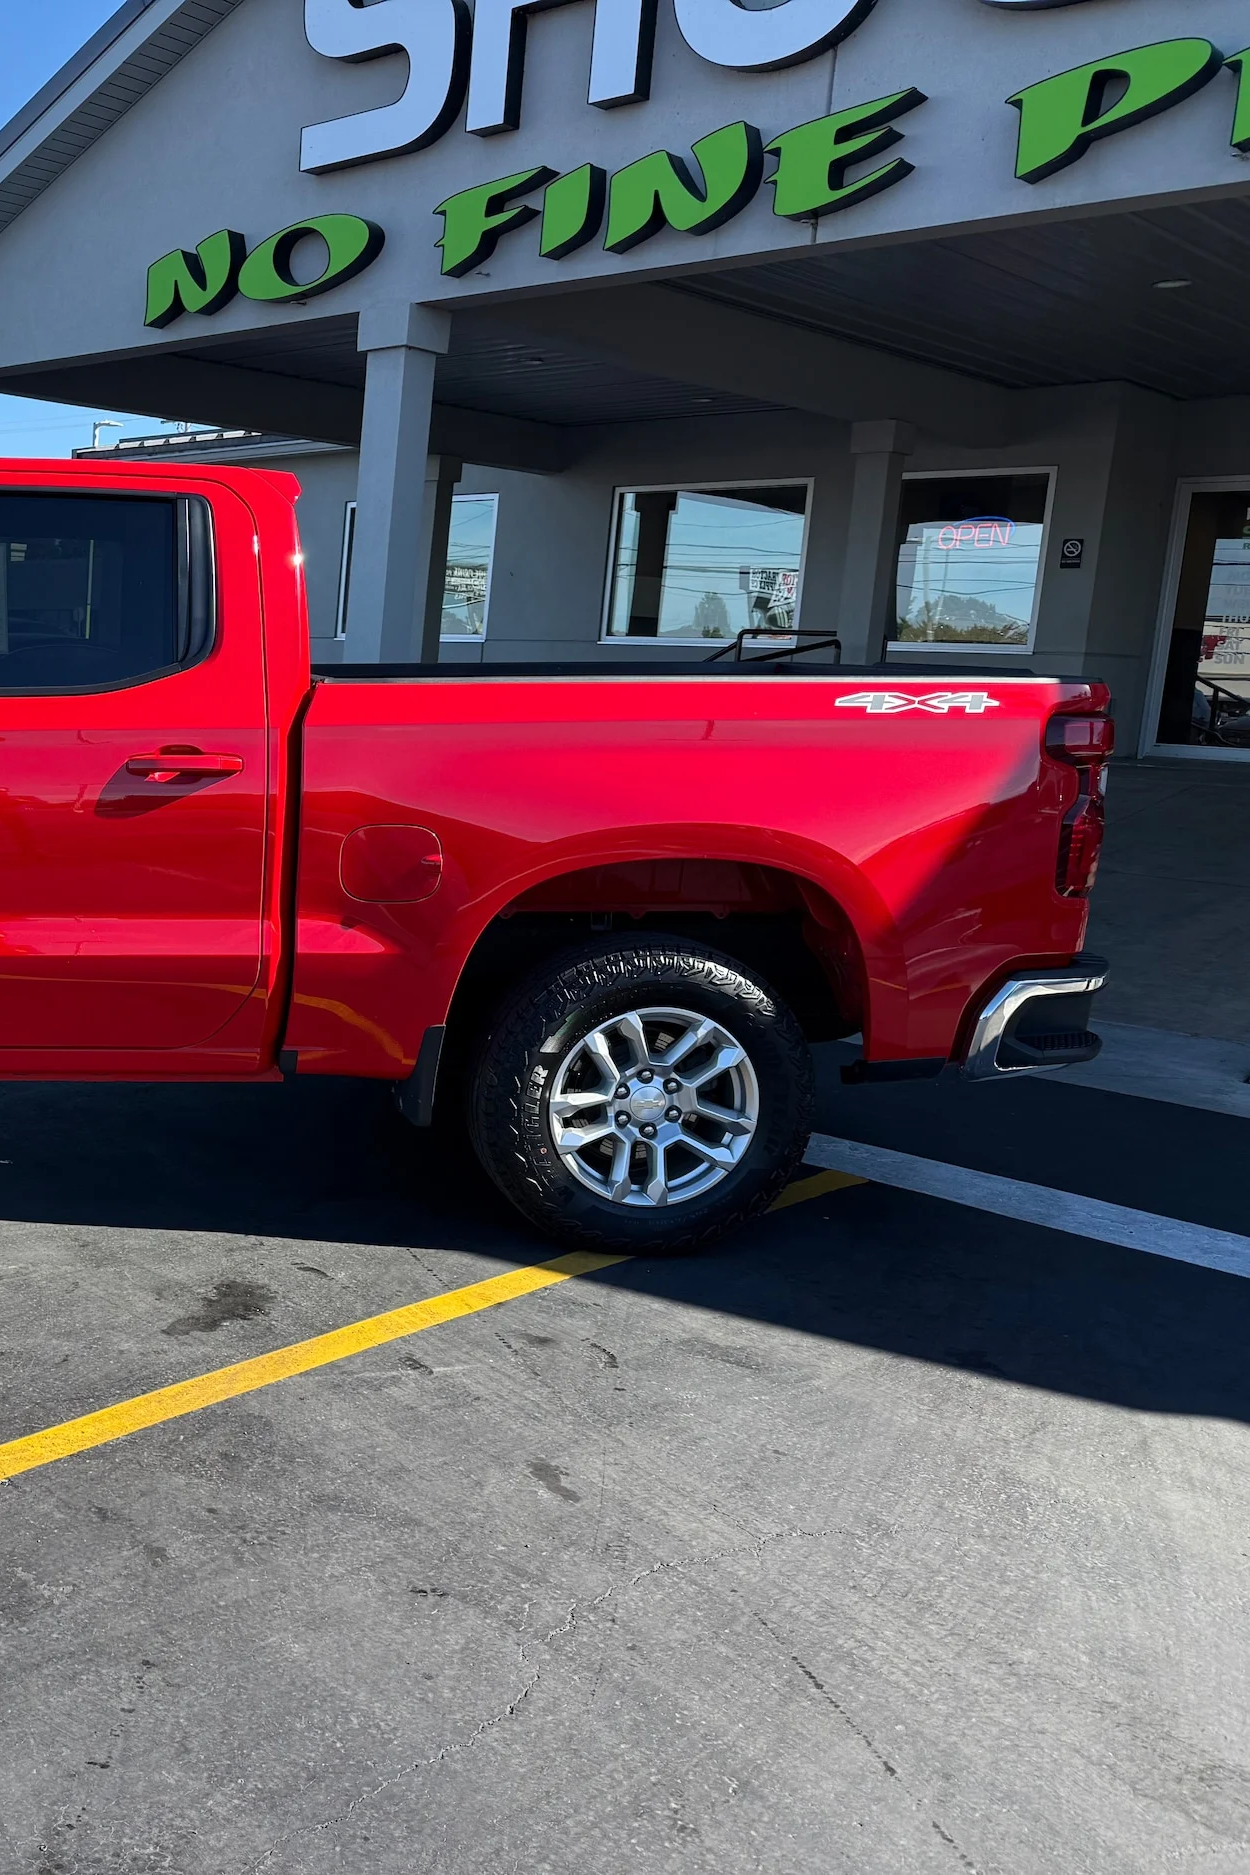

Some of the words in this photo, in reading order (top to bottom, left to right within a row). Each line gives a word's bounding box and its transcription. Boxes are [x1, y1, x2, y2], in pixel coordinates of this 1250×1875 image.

[143, 213, 385, 330] NO
[433, 86, 928, 278] FINE
[1005, 36, 1250, 186] P
[938, 522, 1011, 550] OPEN
[1219, 627, 1240, 637] FRI
[1216, 640, 1242, 651] SAT
[1214, 654, 1245, 665] SUN
